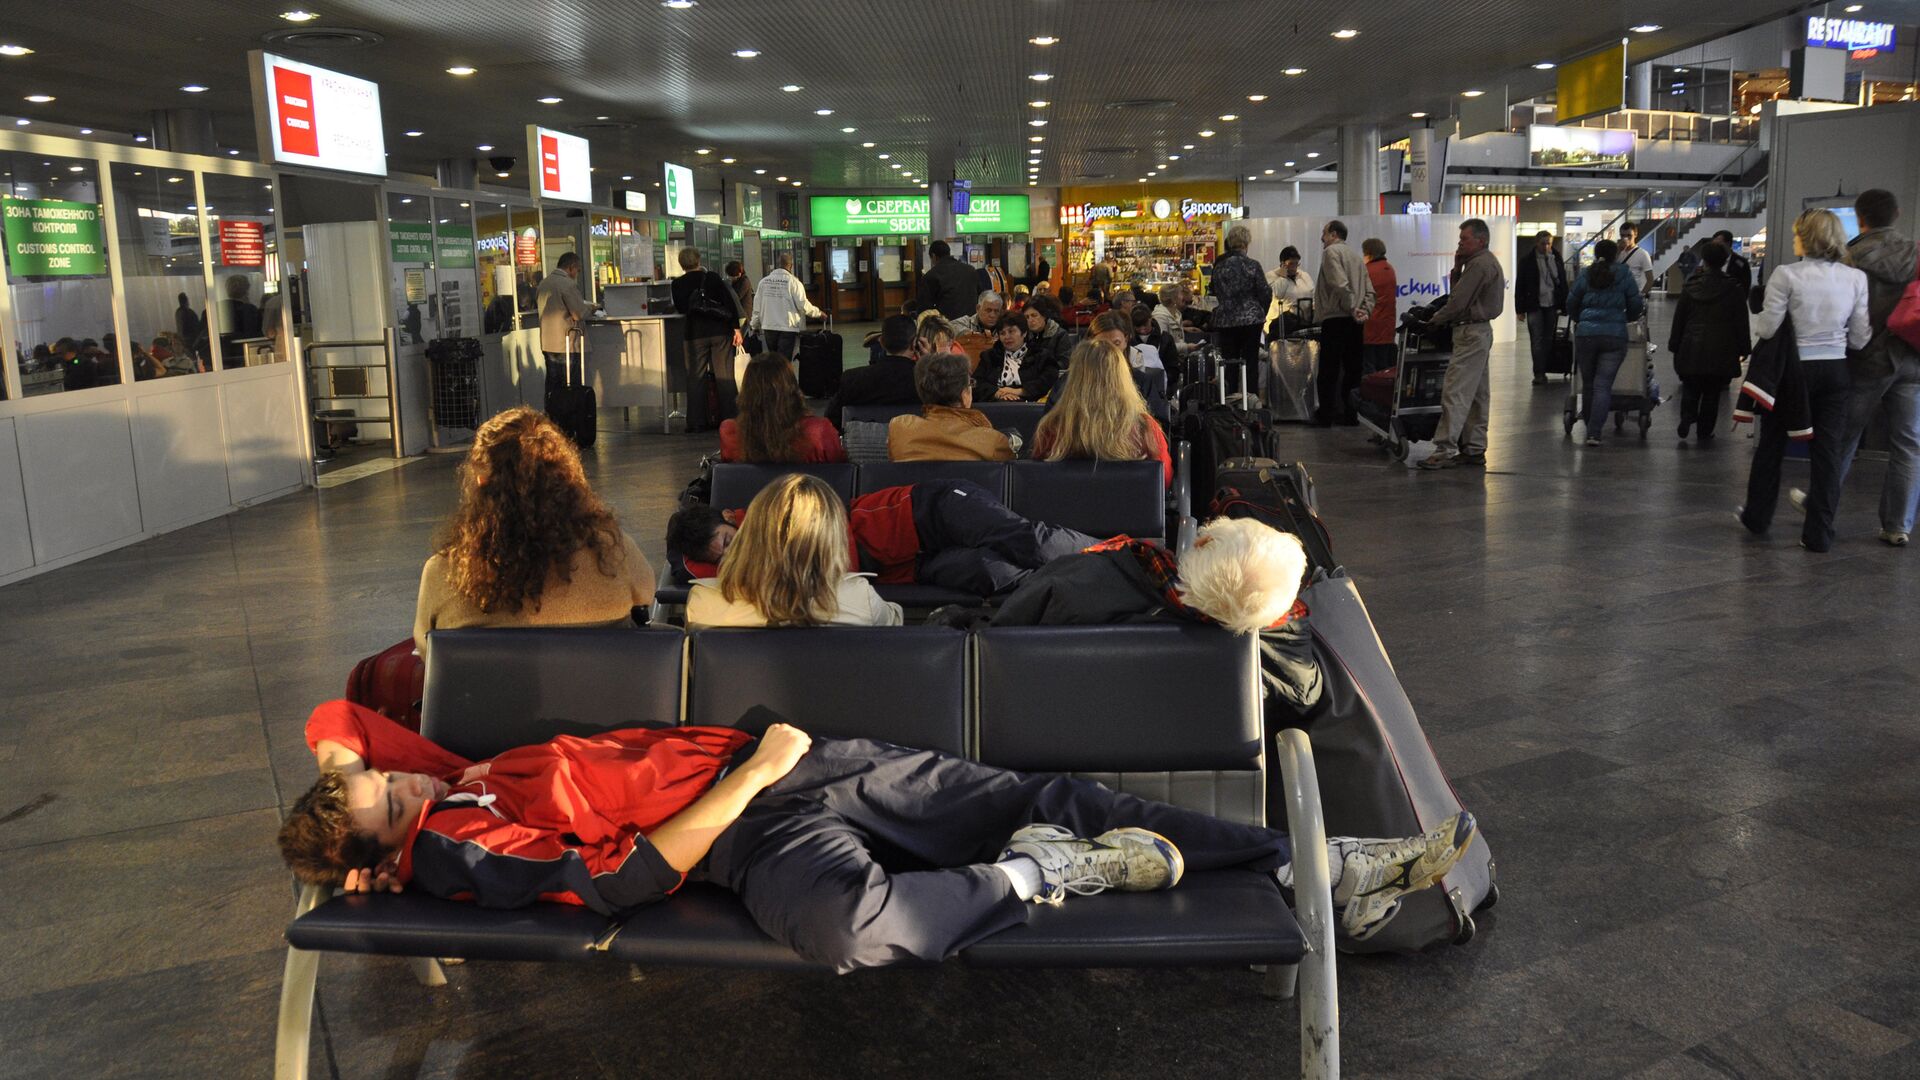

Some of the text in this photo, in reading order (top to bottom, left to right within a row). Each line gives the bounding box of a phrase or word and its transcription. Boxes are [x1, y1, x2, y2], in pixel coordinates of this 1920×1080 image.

[6, 206, 95, 220] ЗОНА ТАМОЖЕННОГО
[866, 200, 930, 214] СБЕРБАН
[969, 200, 1000, 213] СИИ
[1084, 203, 1119, 220] Евросеть
[1182, 198, 1233, 218] Евросеть
[32, 222, 78, 234] КОНТРОЛЯ
[17, 243, 96, 254] CUSTOMS CONTROL
[48, 257, 71, 268] ZONE
